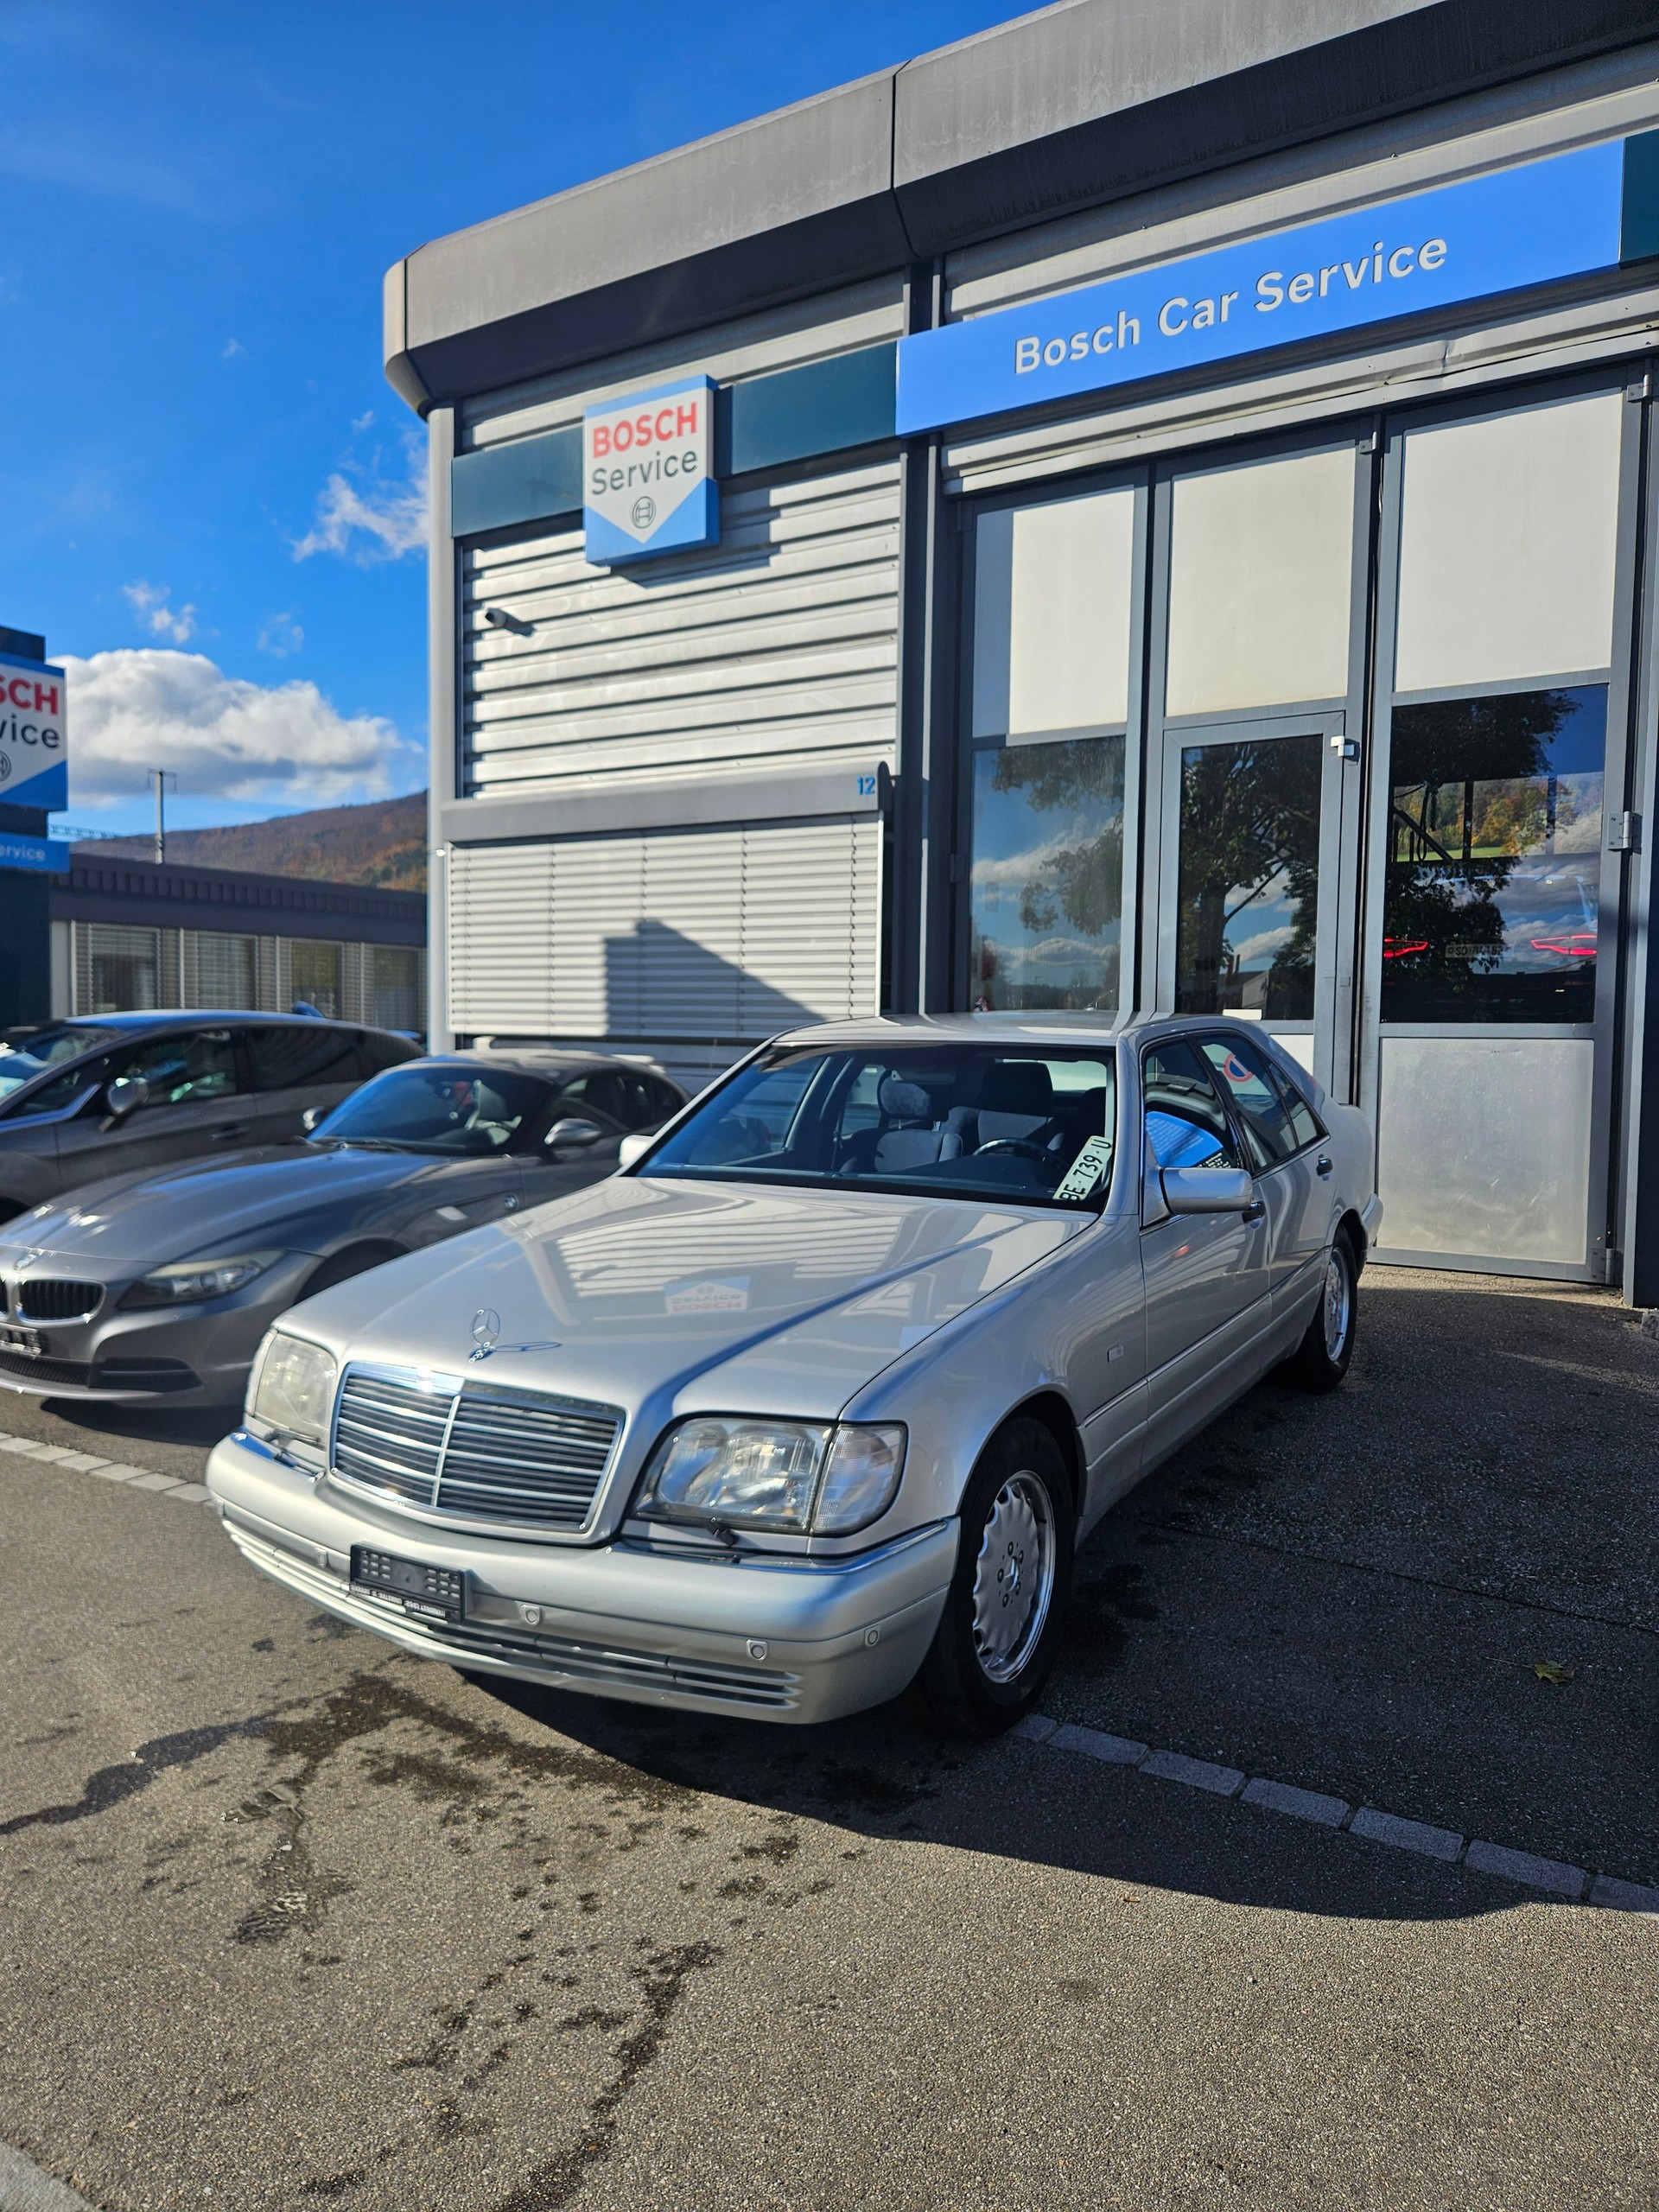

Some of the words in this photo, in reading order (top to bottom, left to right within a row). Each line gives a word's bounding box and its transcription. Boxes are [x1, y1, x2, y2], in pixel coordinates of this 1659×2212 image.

[1015, 310, 1141, 375] Bosch
[1158, 290, 1239, 336] Car
[1254, 237, 1448, 313] Service
[593, 401, 698, 460] BOSCH
[591, 450, 698, 496] Service
[857, 775, 875, 796] 12
